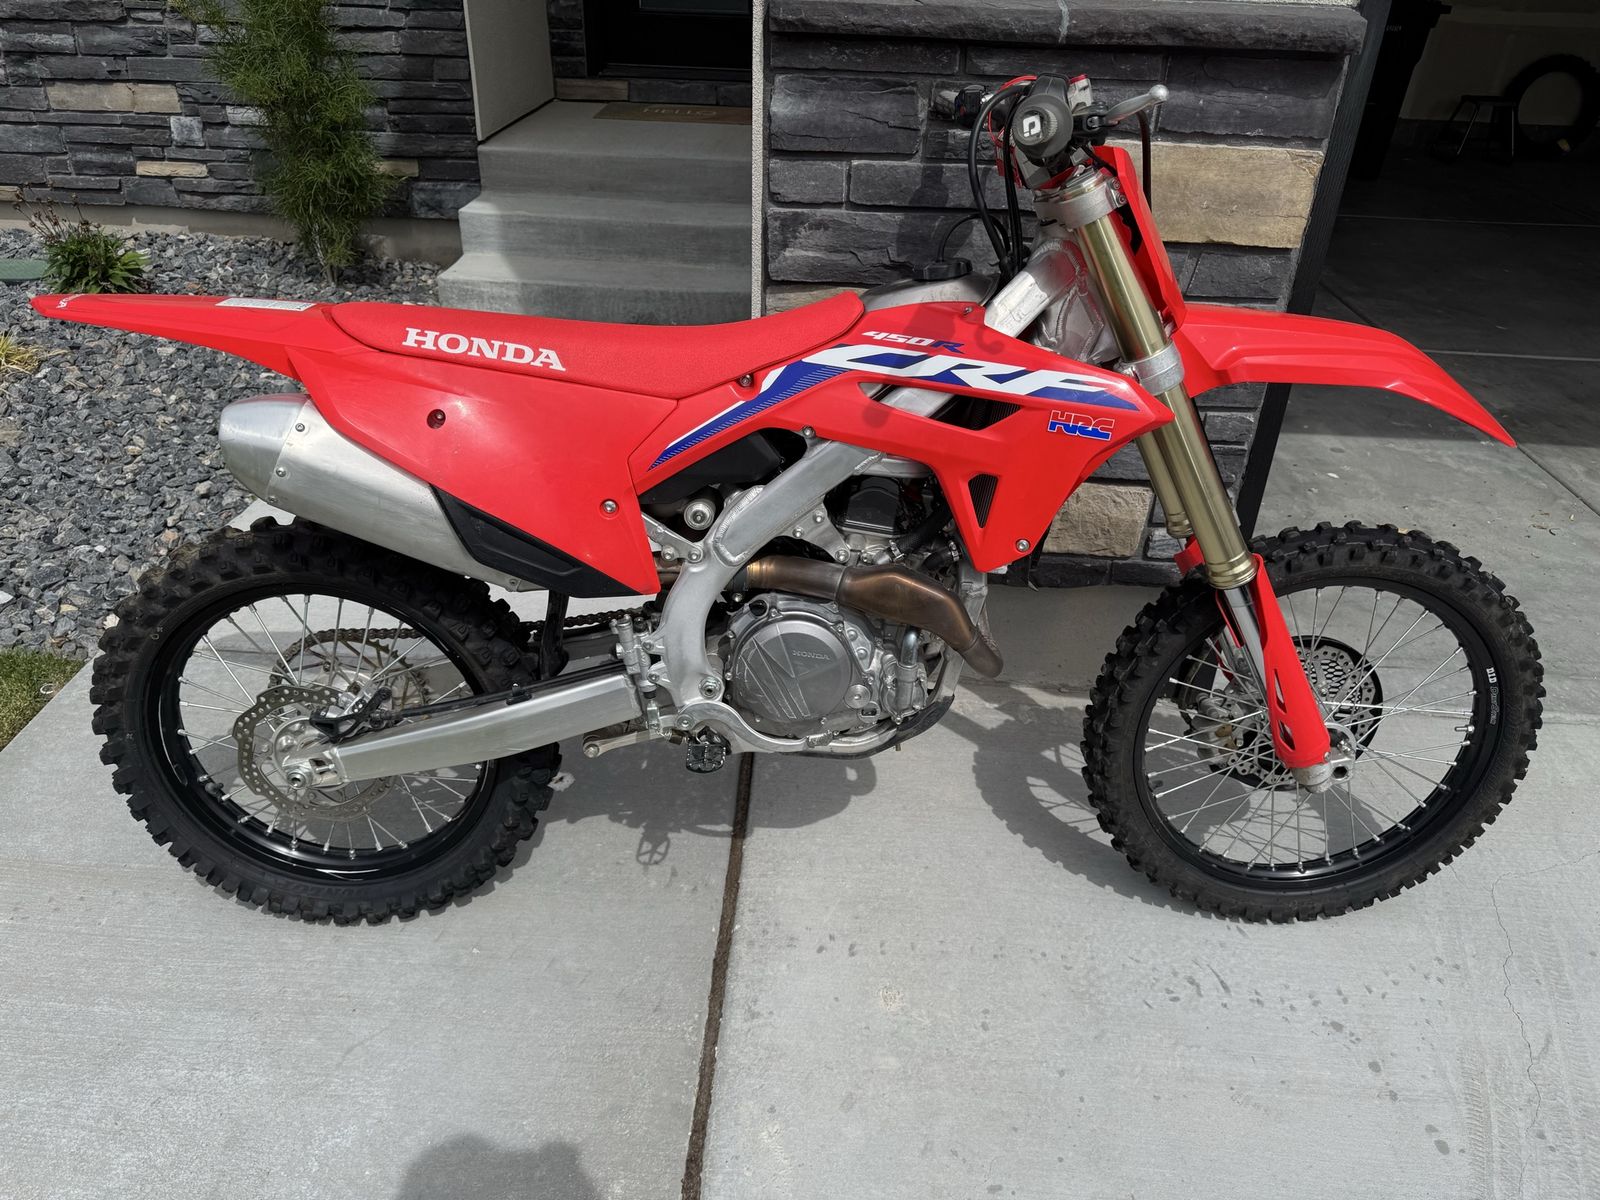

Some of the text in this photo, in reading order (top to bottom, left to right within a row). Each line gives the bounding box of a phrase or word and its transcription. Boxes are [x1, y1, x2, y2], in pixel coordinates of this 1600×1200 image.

[402, 327, 566, 372] HONDA
[862, 331, 965, 354] 450R
[801, 344, 1111, 395] CRF
[1047, 409, 1115, 441] HRC
[792, 650, 830, 660] HONDA
[1486, 667, 1497, 683] DID
